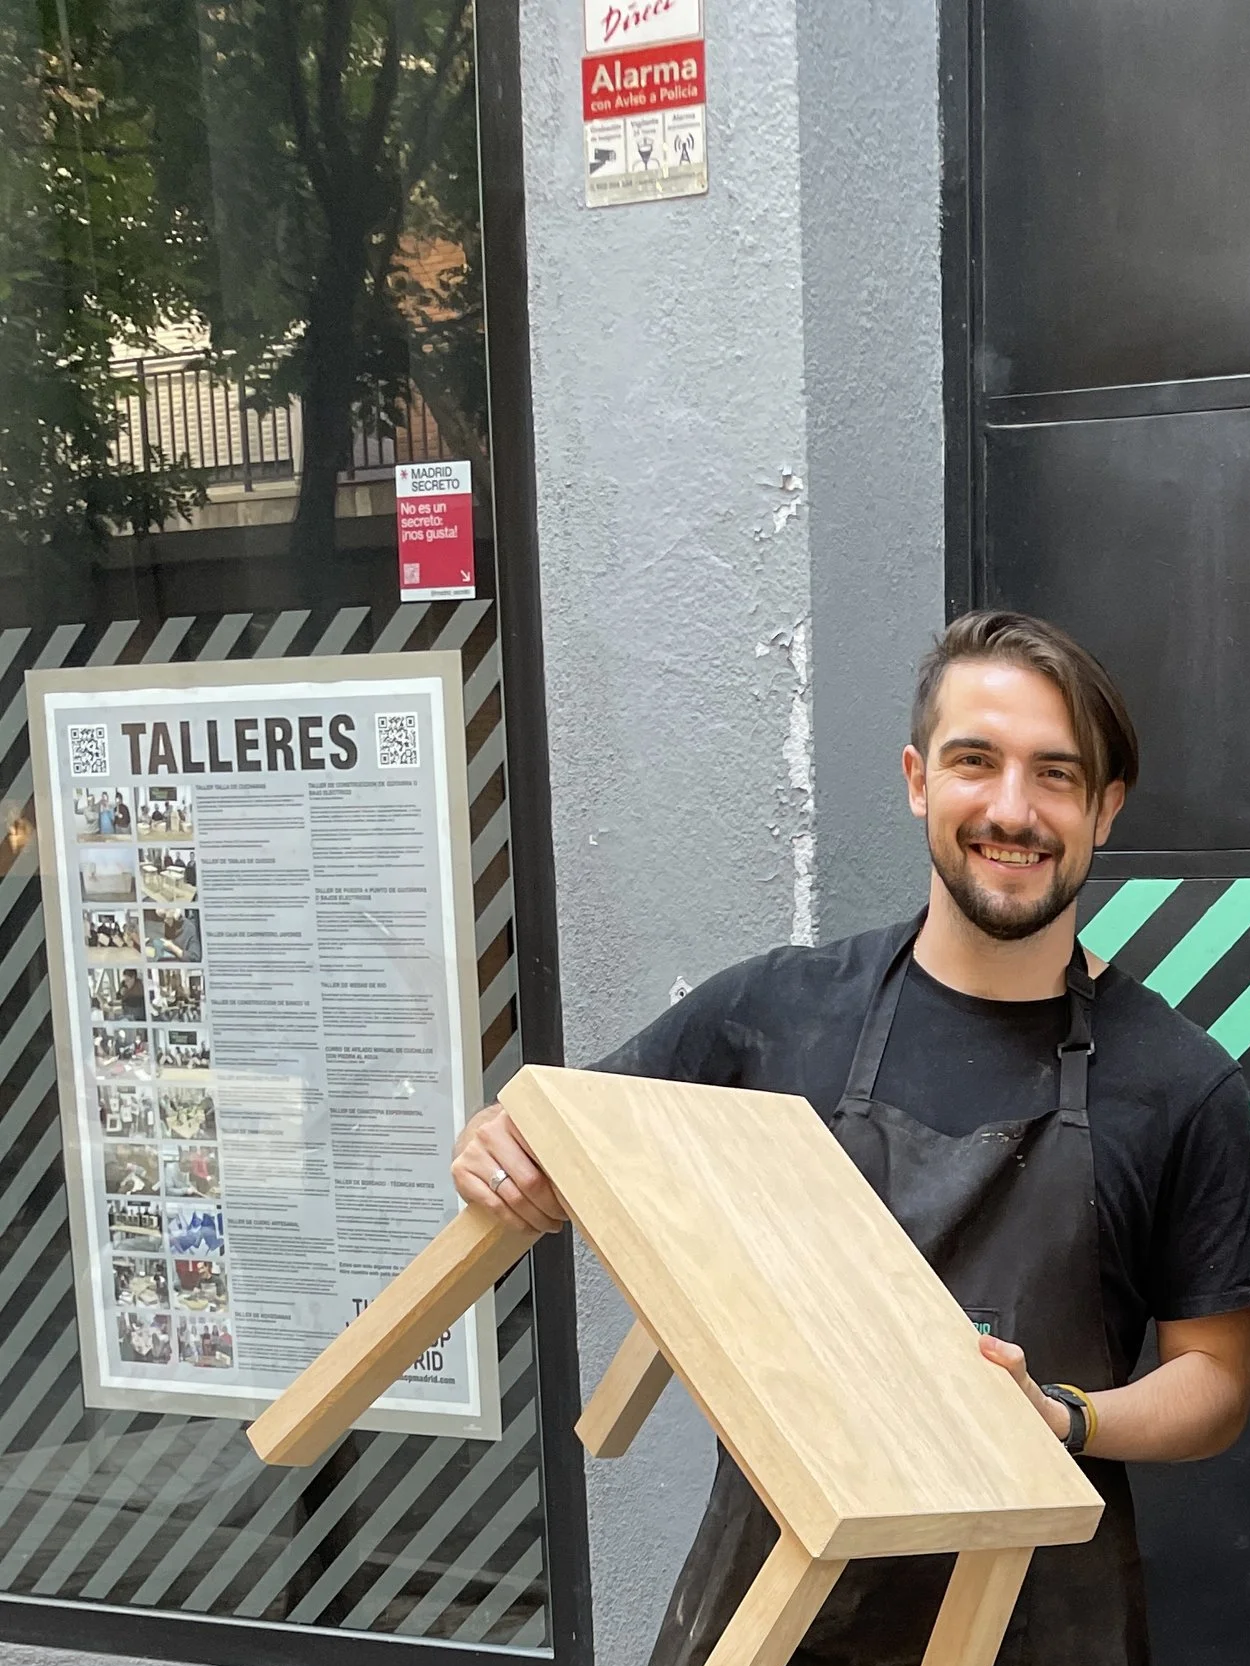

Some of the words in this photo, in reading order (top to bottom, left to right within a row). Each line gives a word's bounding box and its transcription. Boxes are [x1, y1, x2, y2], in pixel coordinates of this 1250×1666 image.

[591, 58, 697, 94] Alarma
[591, 99, 611, 112] con
[615, 90, 646, 108] Aviso
[650, 92, 657, 104] a
[660, 82, 698, 102] Policía
[411, 466, 452, 479] MADRID
[412, 479, 460, 492] SECRETO
[401, 502, 416, 515] No
[418, 504, 431, 514] es
[433, 502, 446, 513] un
[401, 515, 443, 528] secreto:
[402, 530, 424, 543] ¡nos
[426, 526, 458, 543] gusta!
[121, 714, 358, 775] TALLERES
[413, 1351, 443, 1371] RID
